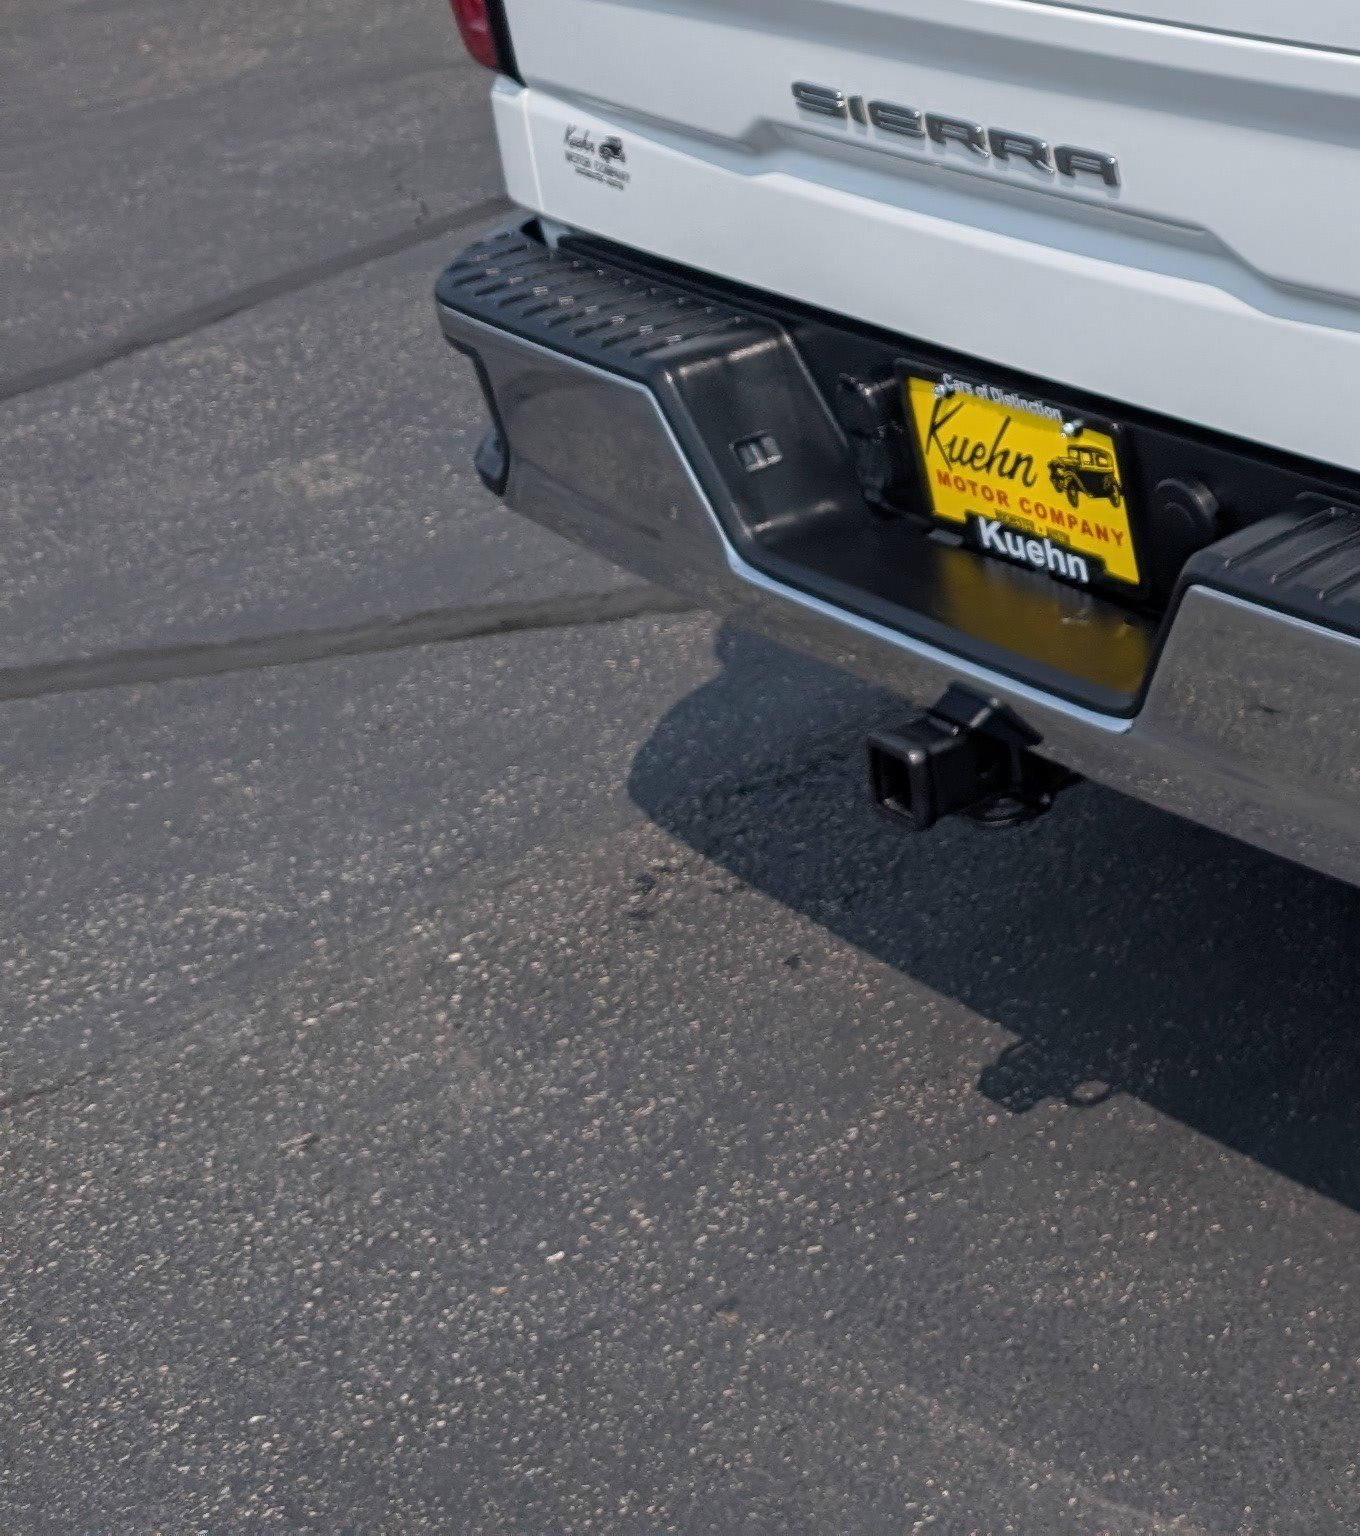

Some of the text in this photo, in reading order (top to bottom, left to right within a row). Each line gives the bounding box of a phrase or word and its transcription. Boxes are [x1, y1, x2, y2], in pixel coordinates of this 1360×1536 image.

[791, 80, 1121, 187] SIERRA
[975, 384, 992, 400] of
[925, 400, 1038, 488] Kuehn
[935, 469, 1011, 508] MOTOR
[1018, 495, 1126, 548] COMPANY
[976, 515, 1089, 585] Kuehn
